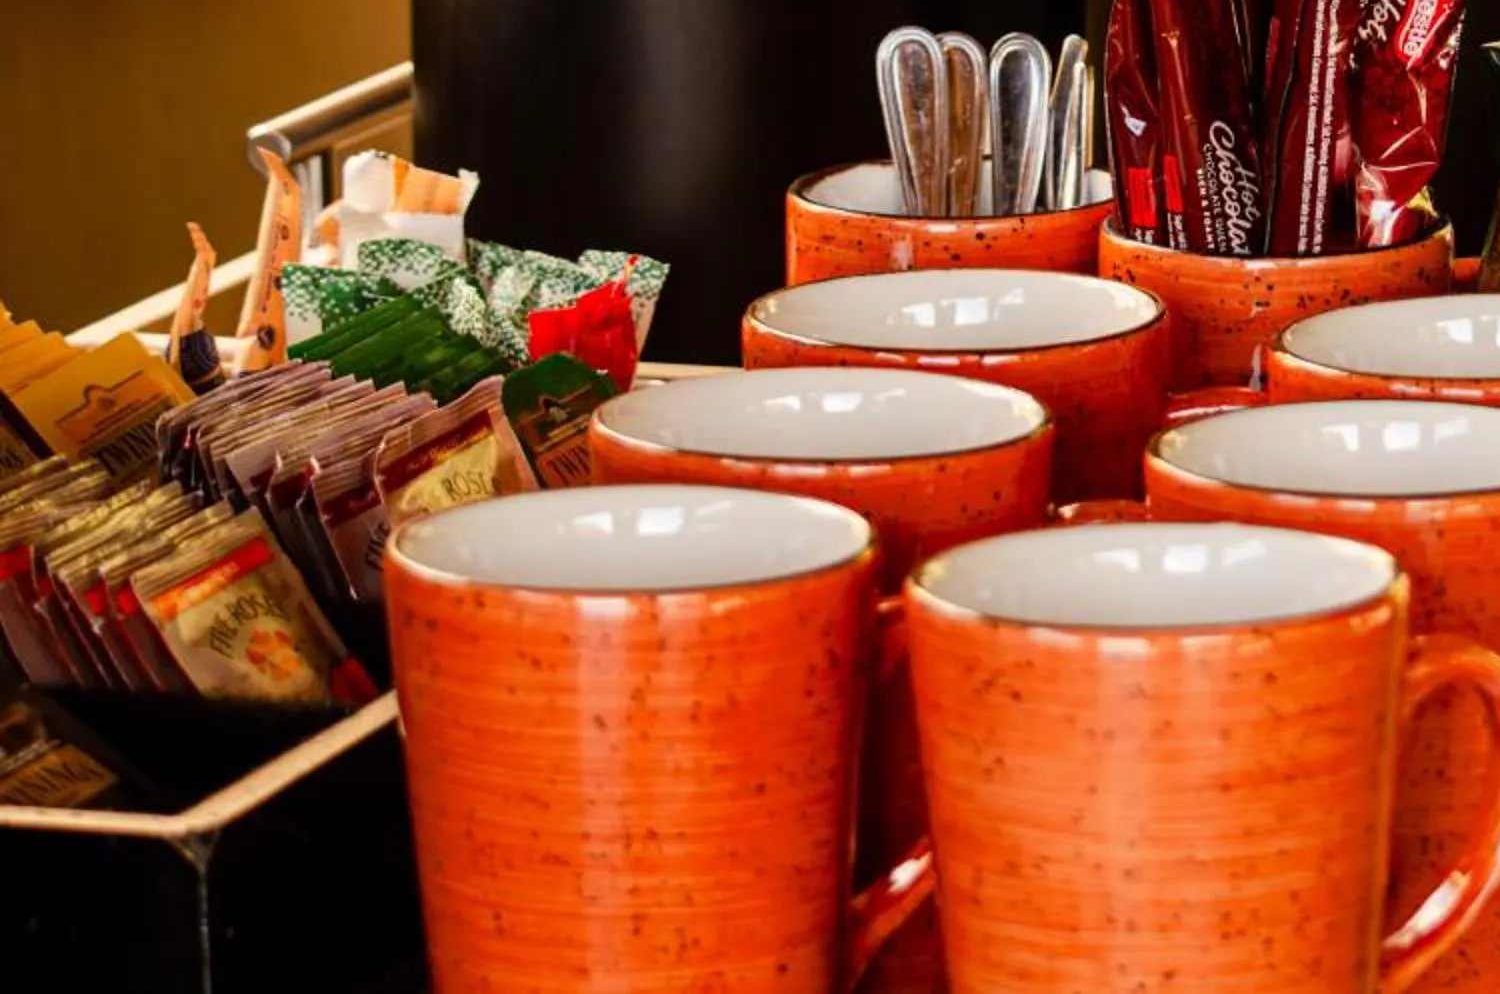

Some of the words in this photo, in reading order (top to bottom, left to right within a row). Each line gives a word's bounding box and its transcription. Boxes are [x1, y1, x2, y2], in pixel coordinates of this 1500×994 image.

[1203, 143, 1221, 214] CHOCOLATE
[1209, 120, 1253, 254] Chocolat
[1236, 165, 1261, 221] Hot
